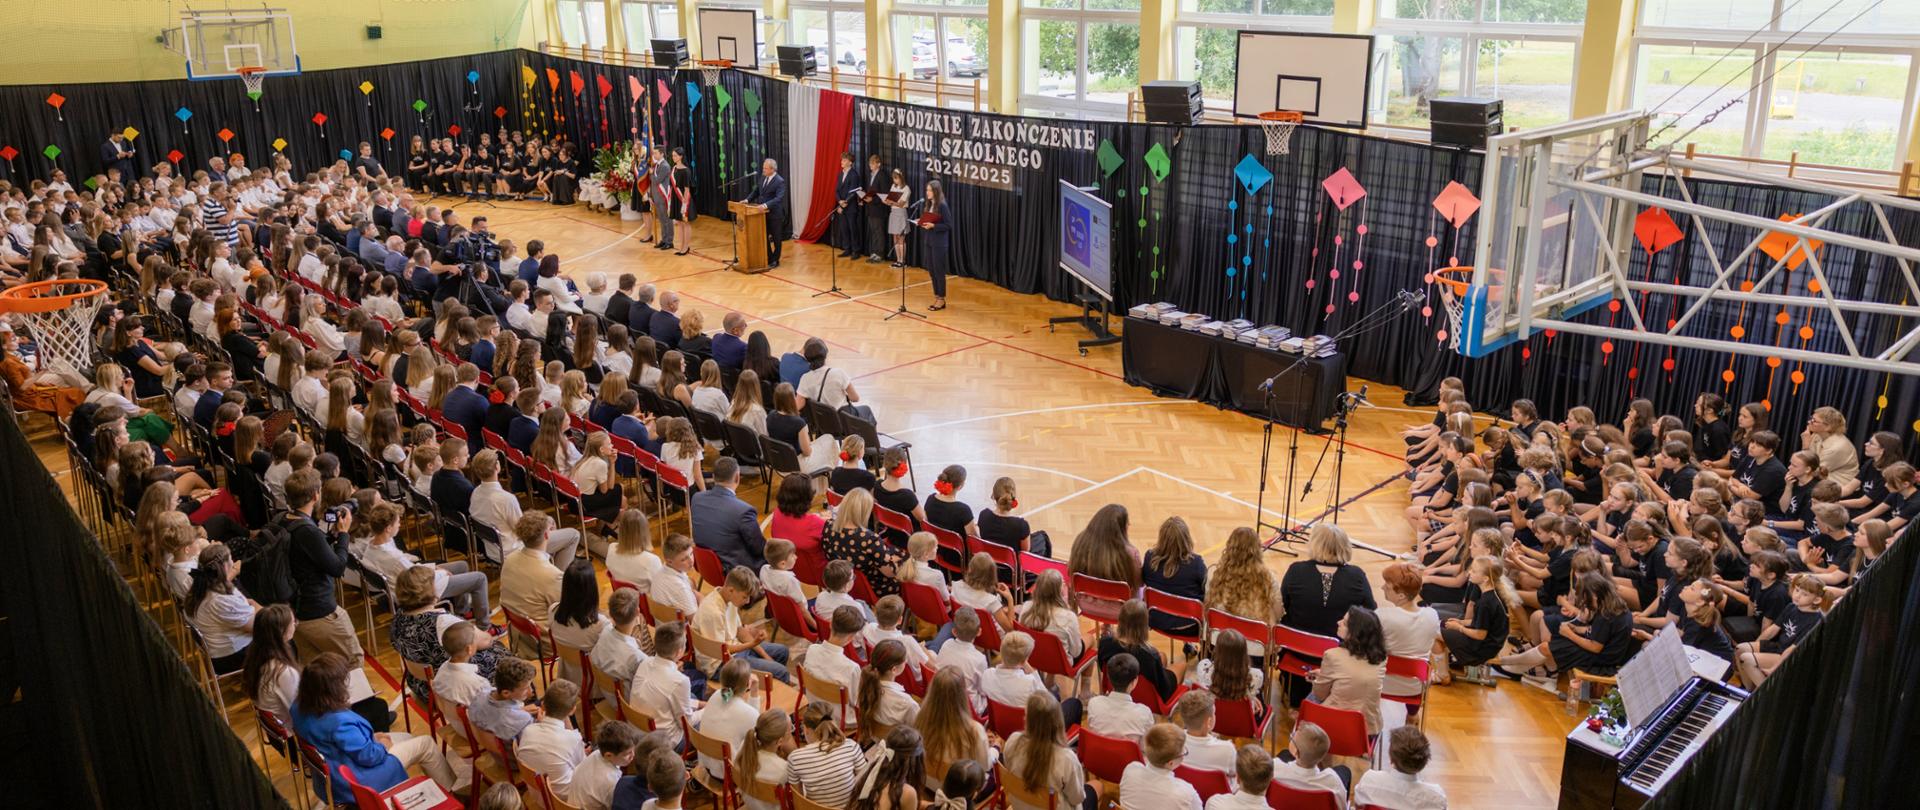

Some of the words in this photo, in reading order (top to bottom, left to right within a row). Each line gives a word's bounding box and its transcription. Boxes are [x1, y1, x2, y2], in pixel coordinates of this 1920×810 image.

[859, 102, 962, 135] WOJEWÓDZKIE
[971, 118, 1096, 151] ZAKOŃCZENIE
[898, 130, 933, 153] ROKU
[941, 137, 1042, 169] SZKOLNEGO
[926, 157, 1010, 184] 2024/2025
